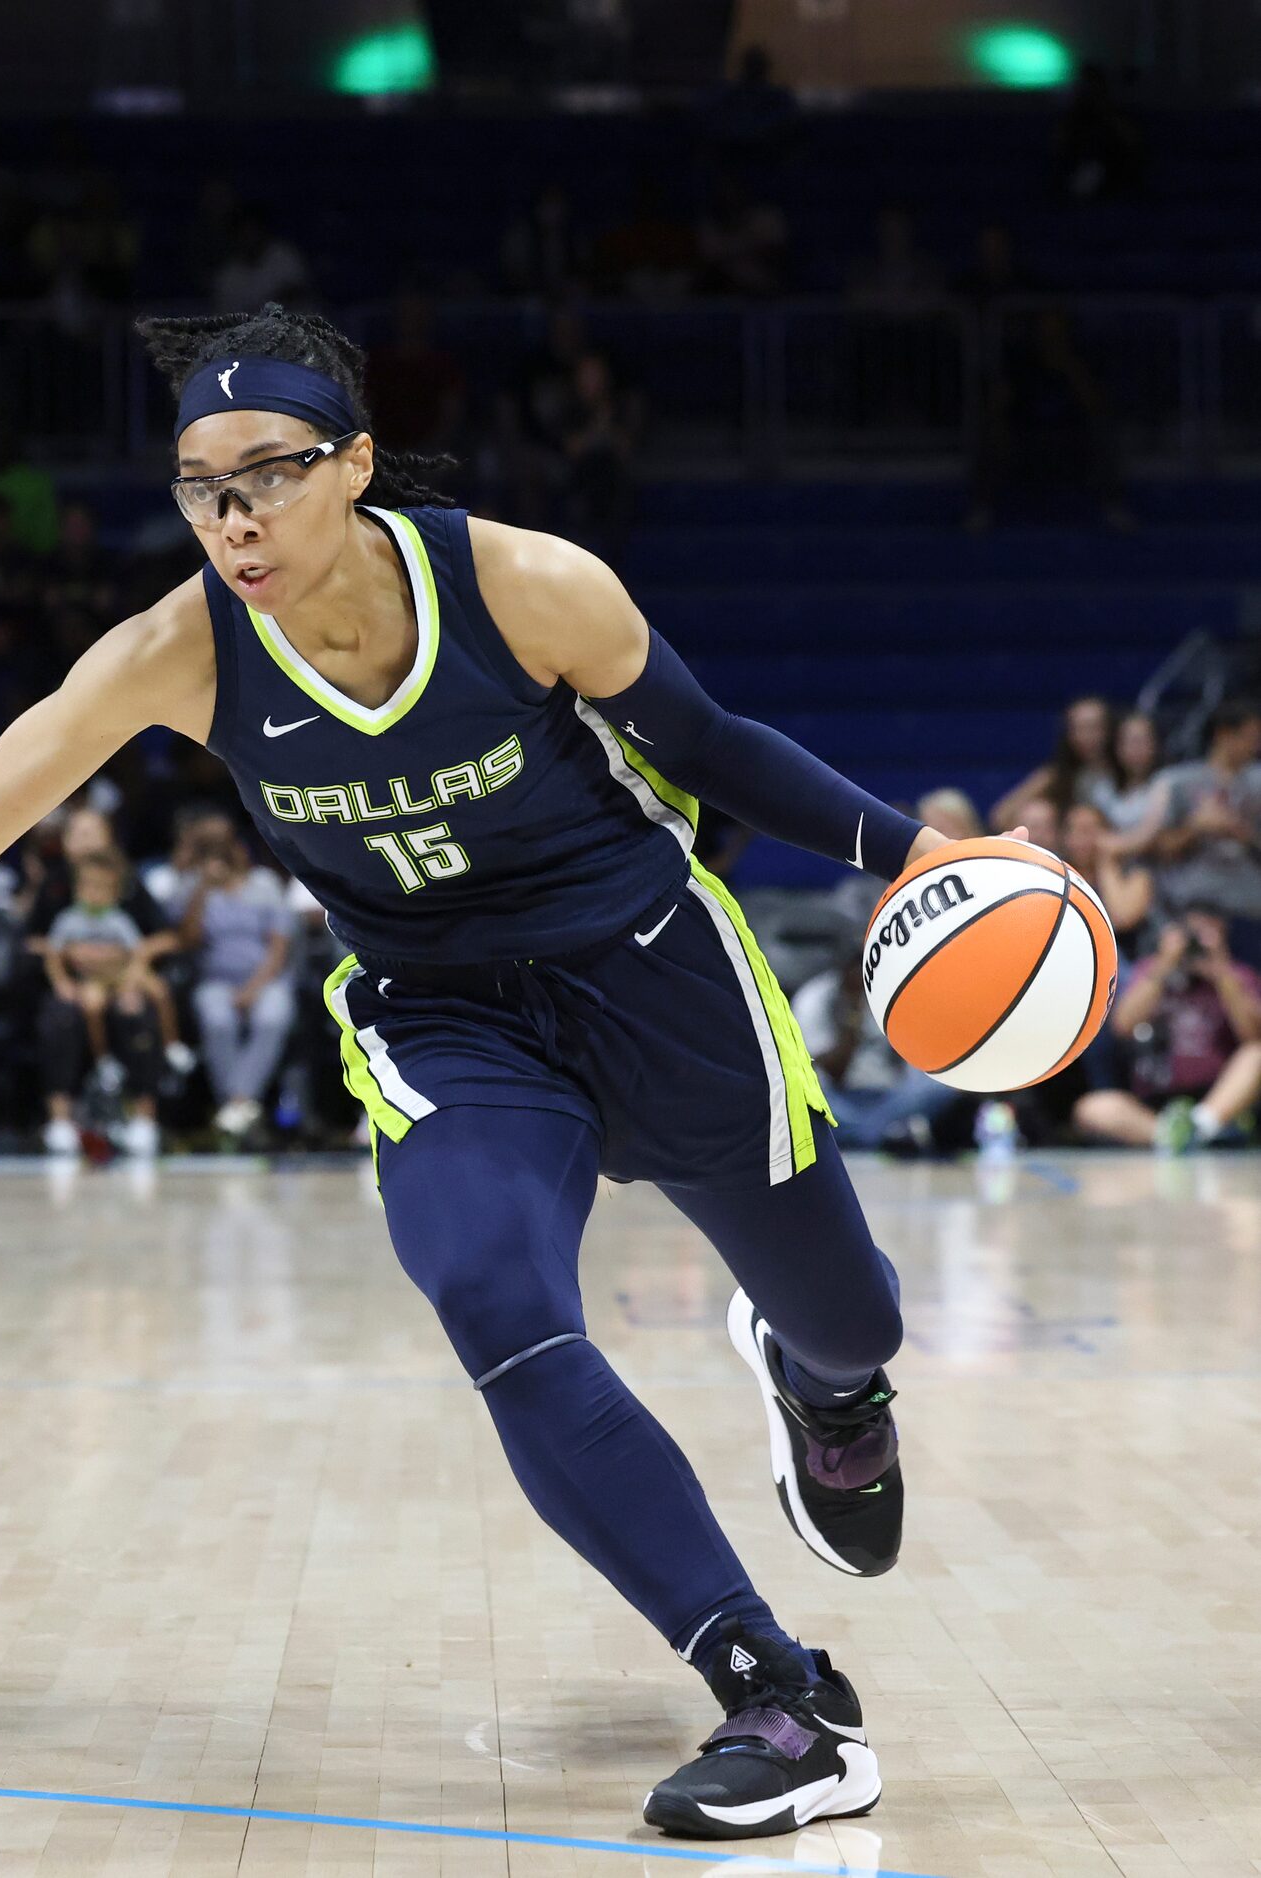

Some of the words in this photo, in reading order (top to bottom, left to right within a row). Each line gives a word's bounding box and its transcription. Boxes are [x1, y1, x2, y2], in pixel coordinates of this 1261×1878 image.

[260, 733, 525, 824] DALLAS
[363, 821, 471, 895] 15
[863, 873, 975, 993] Wilson
